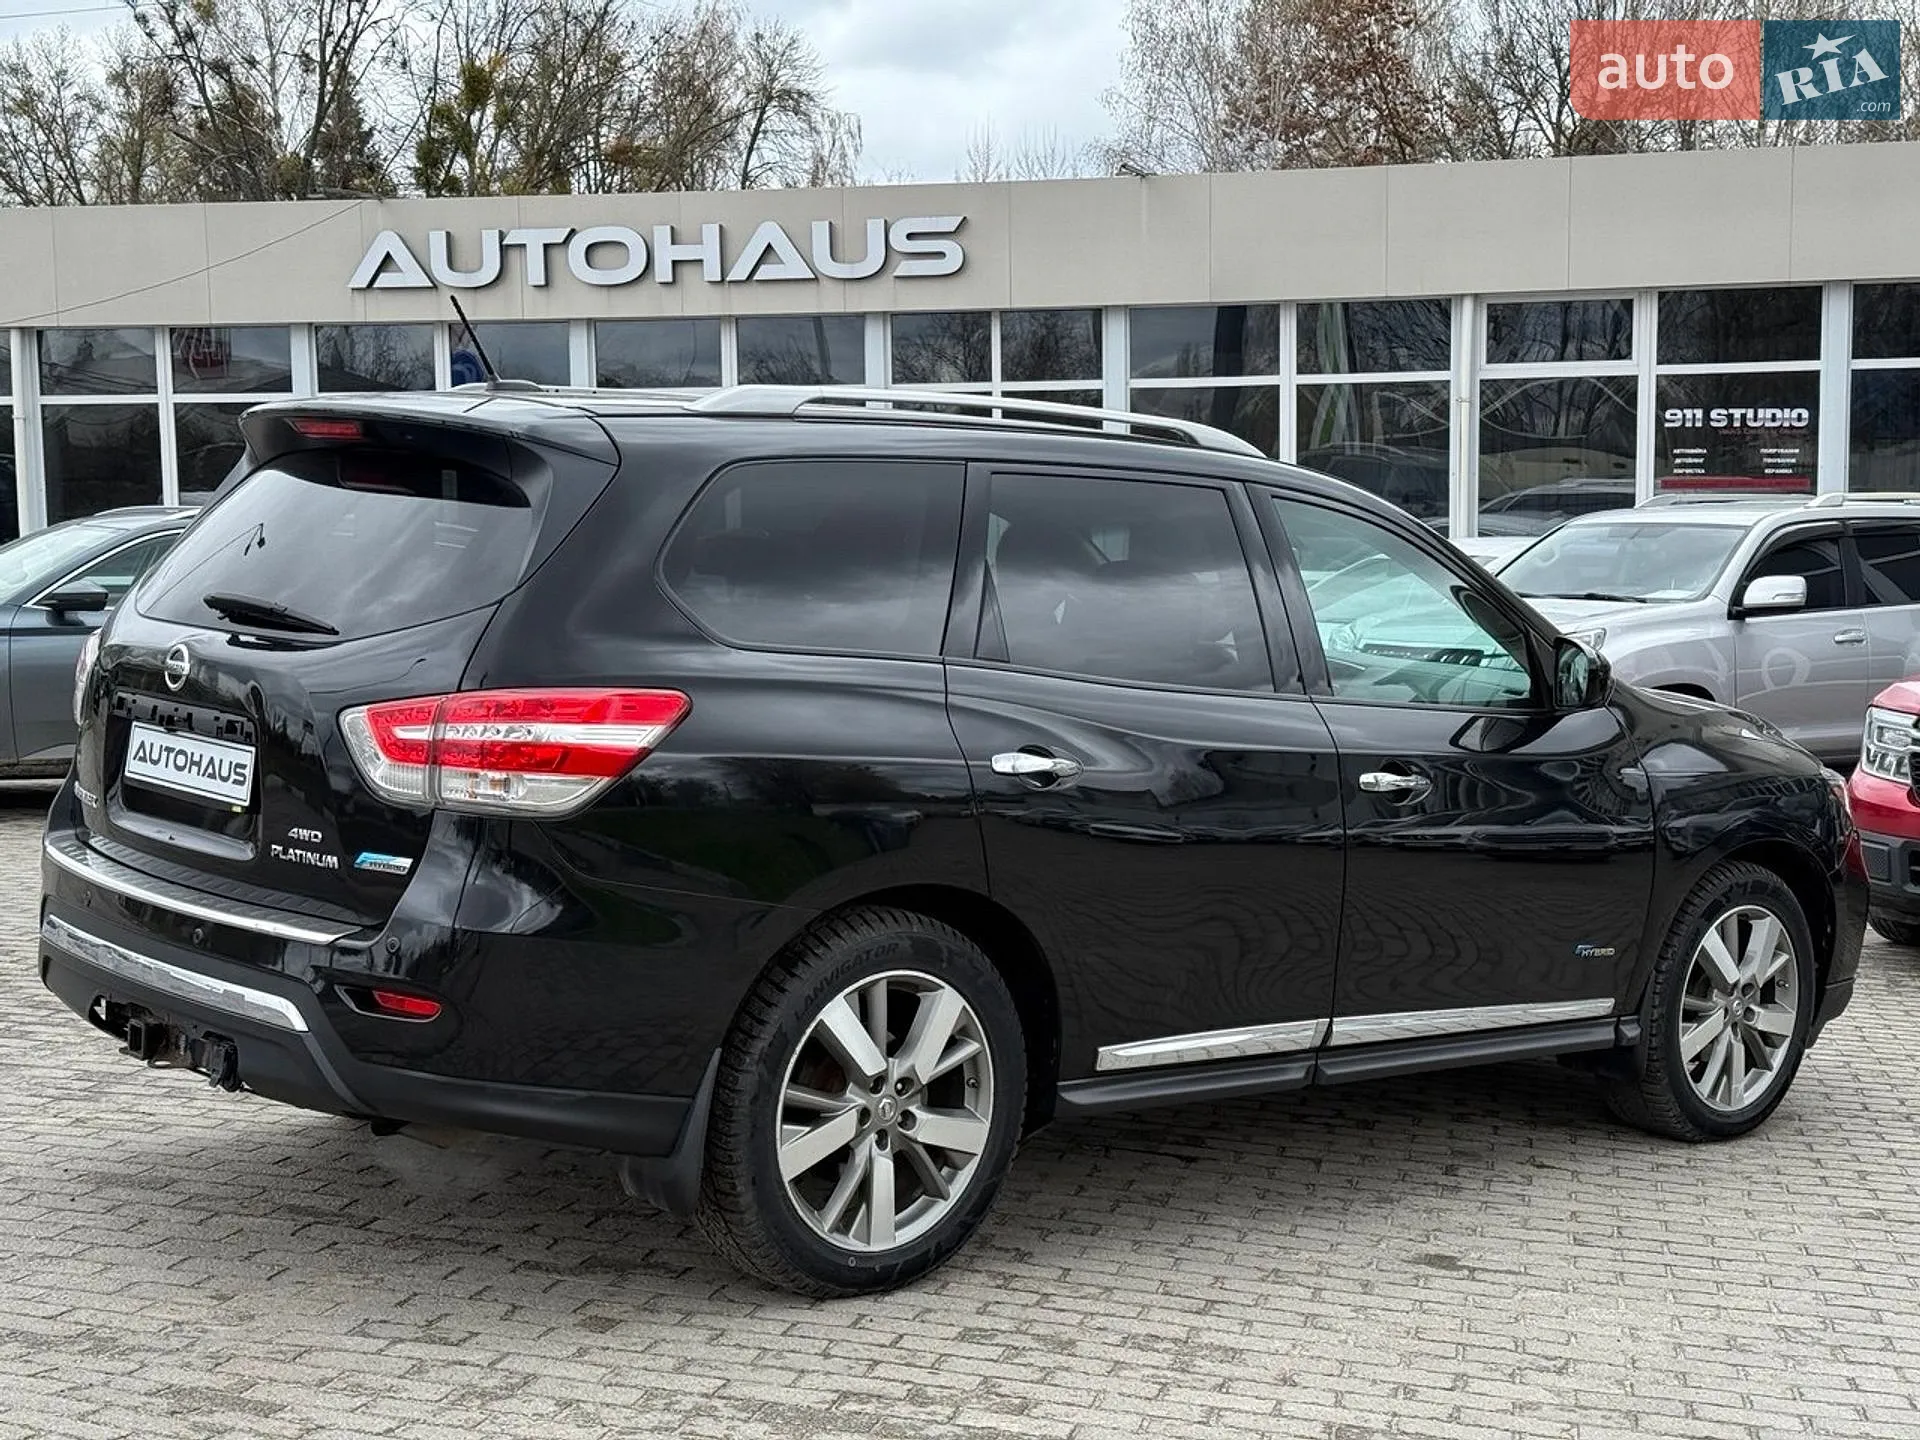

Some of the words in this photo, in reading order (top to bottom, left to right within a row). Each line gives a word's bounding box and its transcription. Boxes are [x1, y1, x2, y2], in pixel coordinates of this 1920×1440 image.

[348, 214, 968, 290] AUTOHAUS
[1664, 408, 1703, 427] 911
[1710, 408, 1809, 427] STUDIO
[132, 739, 248, 787] AUTOHAUS
[287, 827, 322, 843] 4WD
[270, 843, 339, 870] PLATINUM
